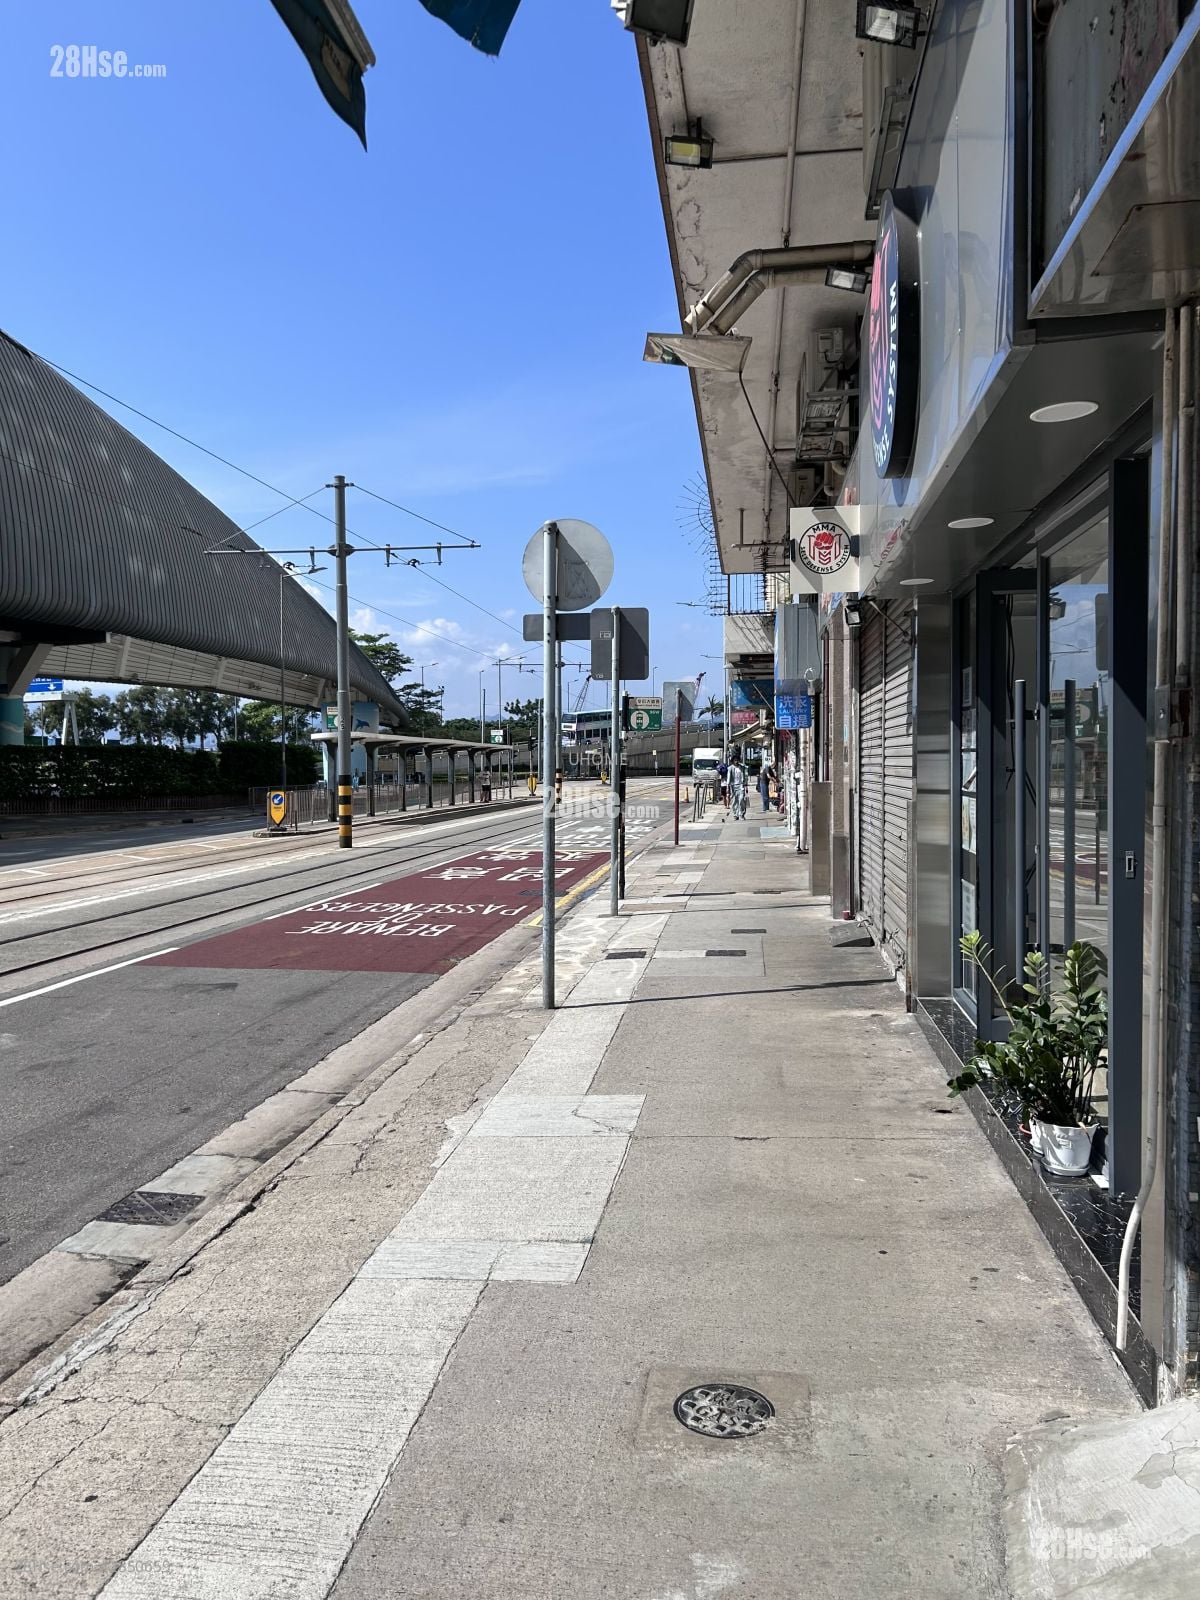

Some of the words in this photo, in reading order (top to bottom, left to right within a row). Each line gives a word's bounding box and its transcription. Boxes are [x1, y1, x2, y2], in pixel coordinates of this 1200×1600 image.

[886, 280, 898, 424] SYSTEM
[812, 524, 837, 534] MMA
[806, 560, 834, 573] DEFENSE
[835, 544, 850, 568] SYSTEM
[780, 695, 808, 709] 洗衣
[780, 715, 809, 728] 自提
[305, 902, 528, 917] PASSENGERS
[370, 912, 426, 924] OF
[285, 920, 457, 937] BEWARE
